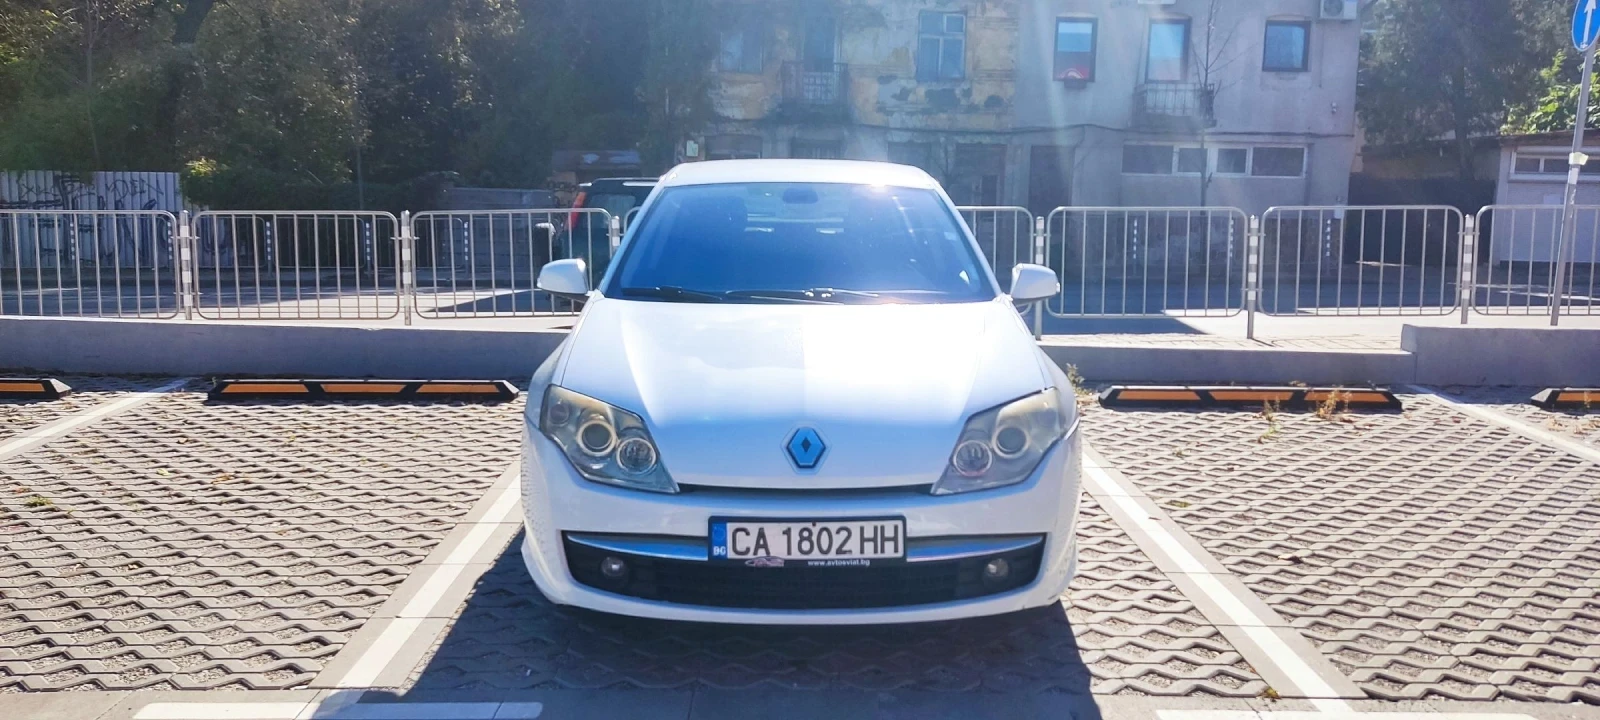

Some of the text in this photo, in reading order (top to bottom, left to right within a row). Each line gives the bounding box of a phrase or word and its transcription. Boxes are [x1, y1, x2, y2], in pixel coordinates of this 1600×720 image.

[713, 545, 726, 556] BG
[732, 524, 899, 556] CA 1802 HH
